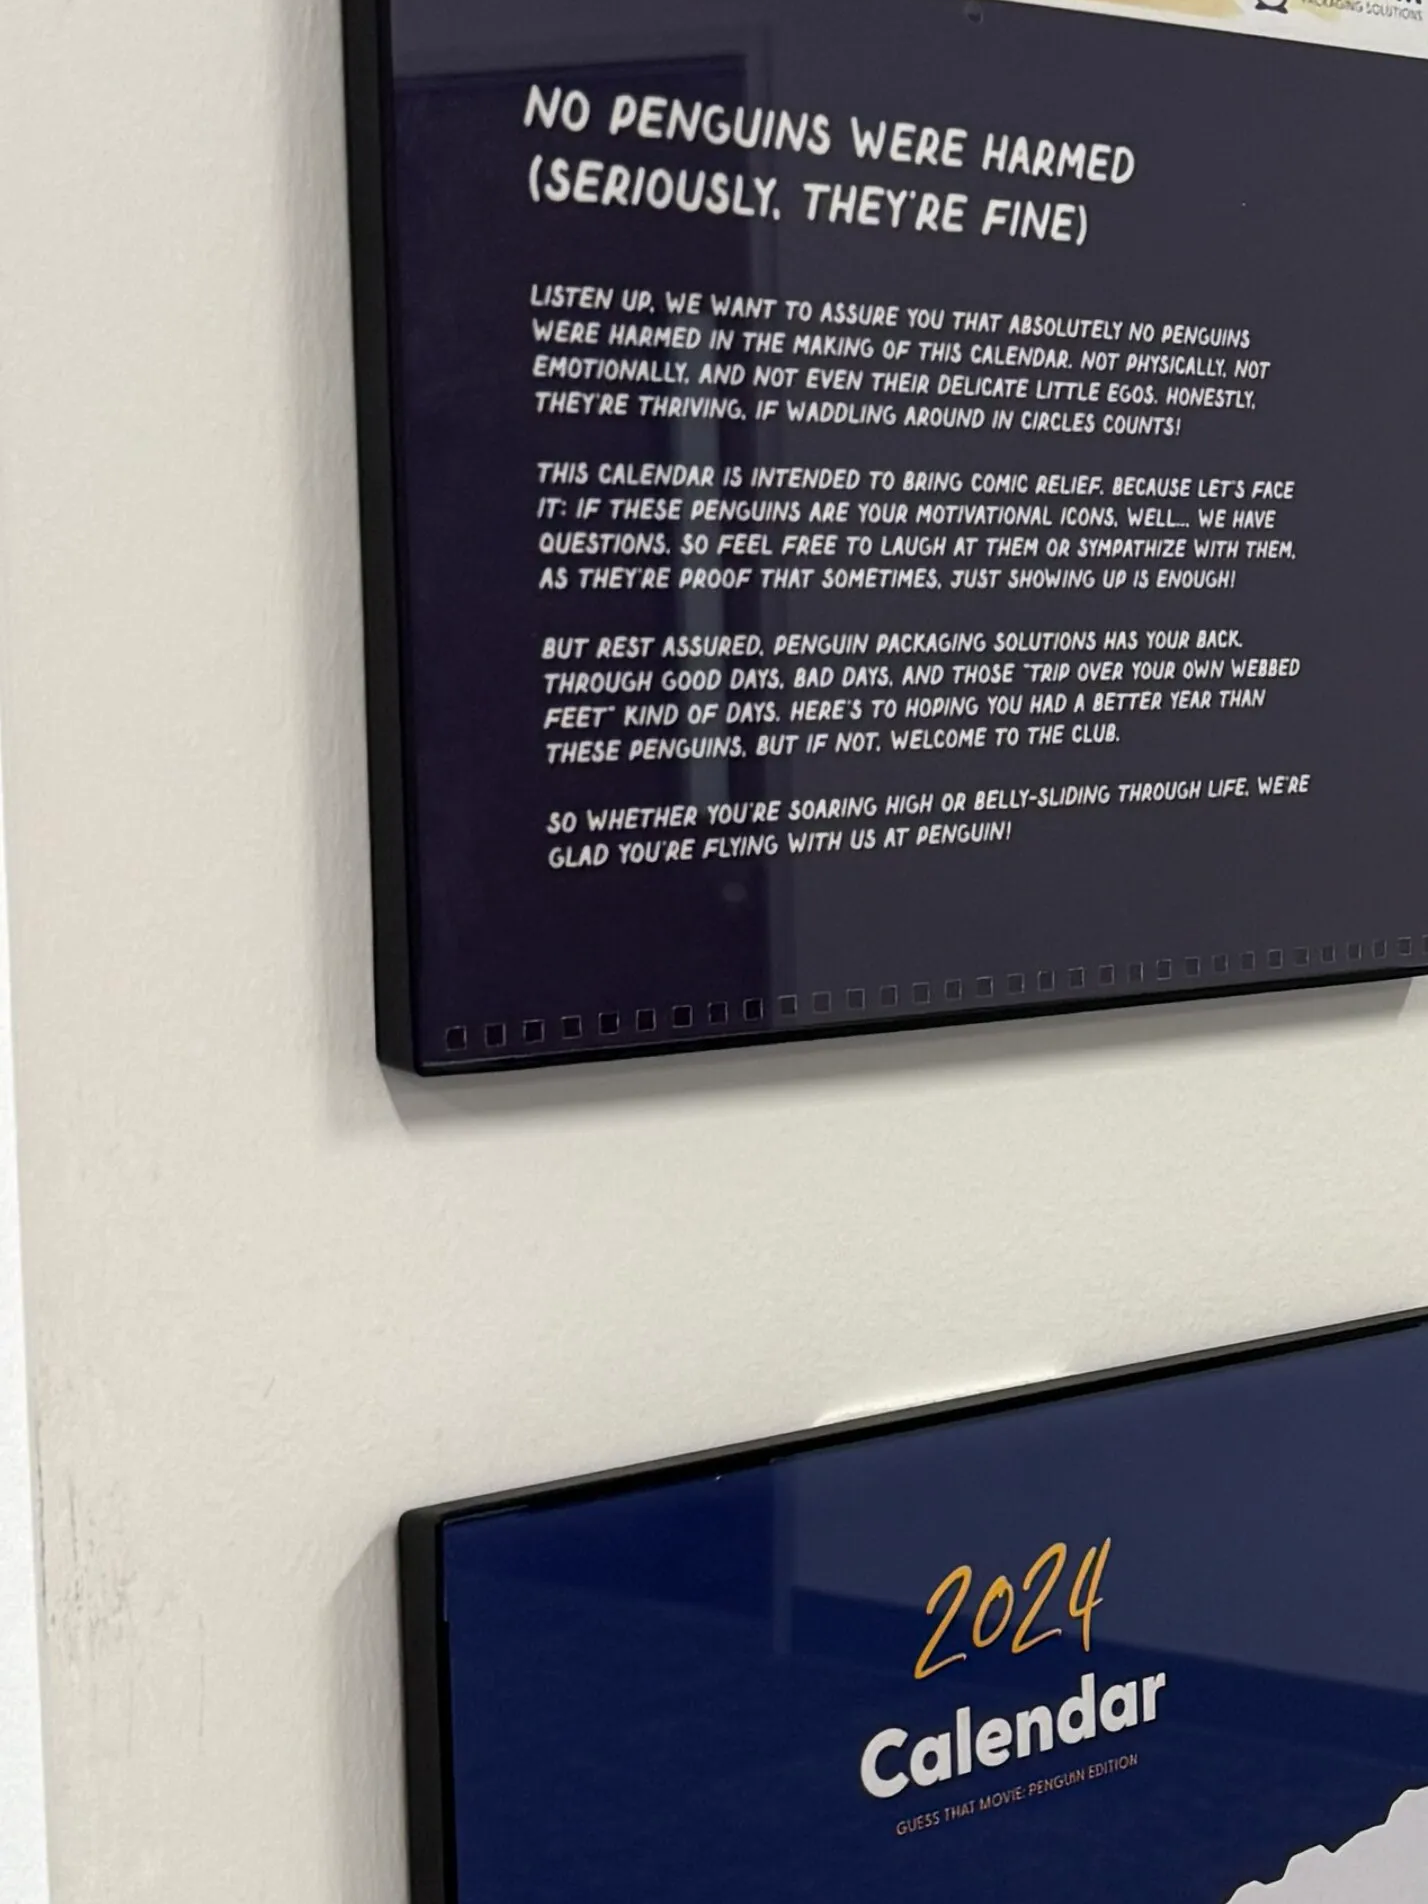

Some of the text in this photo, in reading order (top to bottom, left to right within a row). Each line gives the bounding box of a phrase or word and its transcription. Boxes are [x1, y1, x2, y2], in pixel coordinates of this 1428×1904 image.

[524, 86, 1134, 182] NO PENGUINS WERE HARMED
[804, 184, 968, 231] THEY'RE
[982, 200, 1086, 244] FINE)
[531, 285, 613, 308] LISTEN
[666, 292, 702, 314] WE
[711, 295, 777, 318] WANT
[786, 301, 812, 321] TO
[820, 303, 899, 326] ASSURE
[908, 309, 944, 329] YOU
[953, 312, 1002, 331] THAT
[1009, 316, 1123, 339] ABSOLUTELY
[1129, 323, 1154, 342] NO
[1162, 325, 1250, 348] PENGUINS
[538, 462, 588, 484] THIS
[598, 464, 714, 486] CALENDAR
[724, 466, 742, 487] IS
[751, 468, 860, 488] INTENDED
[870, 471, 895, 490] TO
[903, 472, 962, 491] BRING
[972, 474, 1028, 492] COMIC
[1112, 477, 1192, 496] BECAUSE
[1198, 479, 1244, 498] LET'S
[1252, 481, 1294, 498] FACE
[542, 638, 589, 659] BUT
[596, 636, 655, 658] REST
[774, 634, 868, 654] PENGUIN
[876, 634, 986, 652] PACKAGING
[994, 632, 1096, 651] SOLUTIONS
[1104, 631, 1138, 649] HAS
[1147, 631, 1190, 648] YOUR
[913, 1536, 1112, 1680] 2024
[859, 1671, 1167, 1799] Calendar
[896, 1812, 940, 1834] GUESS
[944, 1801, 974, 1820] THAT
[1029, 1770, 1084, 1795] PENGUIN
[1088, 1754, 1137, 1778] EDITION
